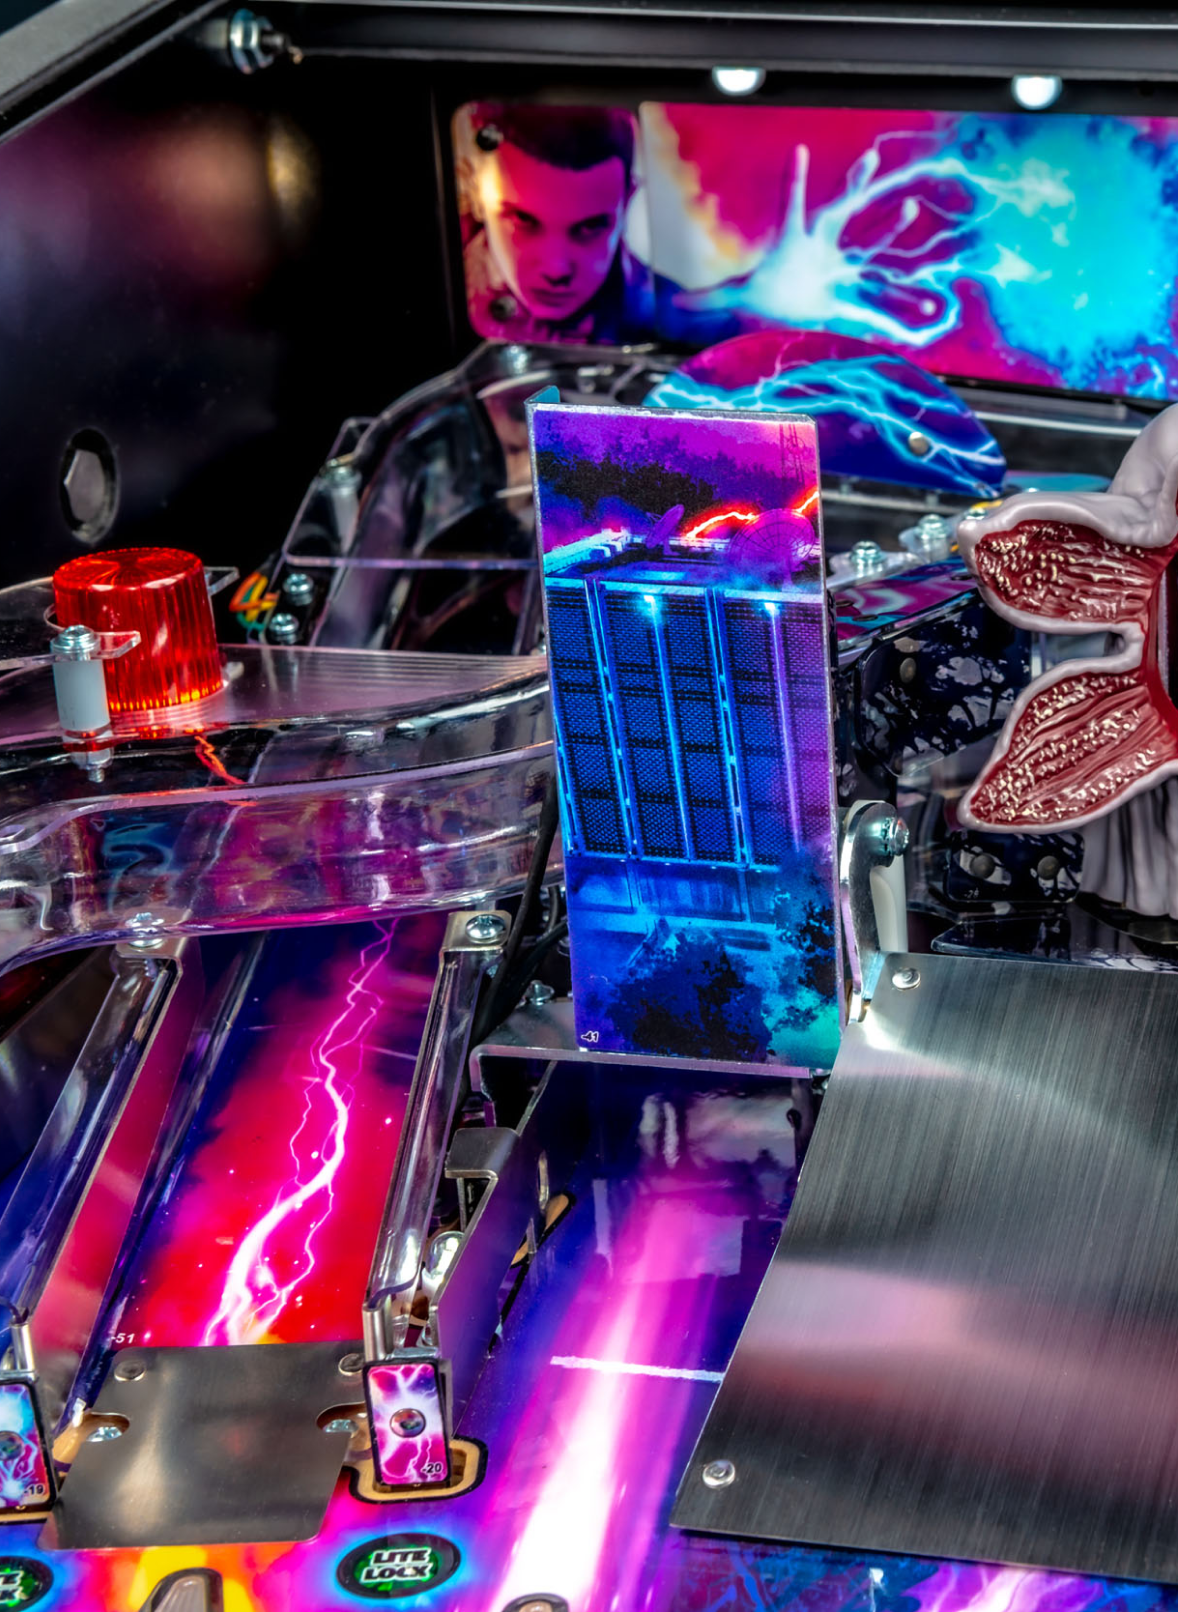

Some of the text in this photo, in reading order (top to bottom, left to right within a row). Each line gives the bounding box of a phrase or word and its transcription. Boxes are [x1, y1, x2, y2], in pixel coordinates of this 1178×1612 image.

[421, 1462, 443, 1474] -20
[371, 1548, 431, 1565] LITE
[361, 1563, 433, 1583] LOCK
